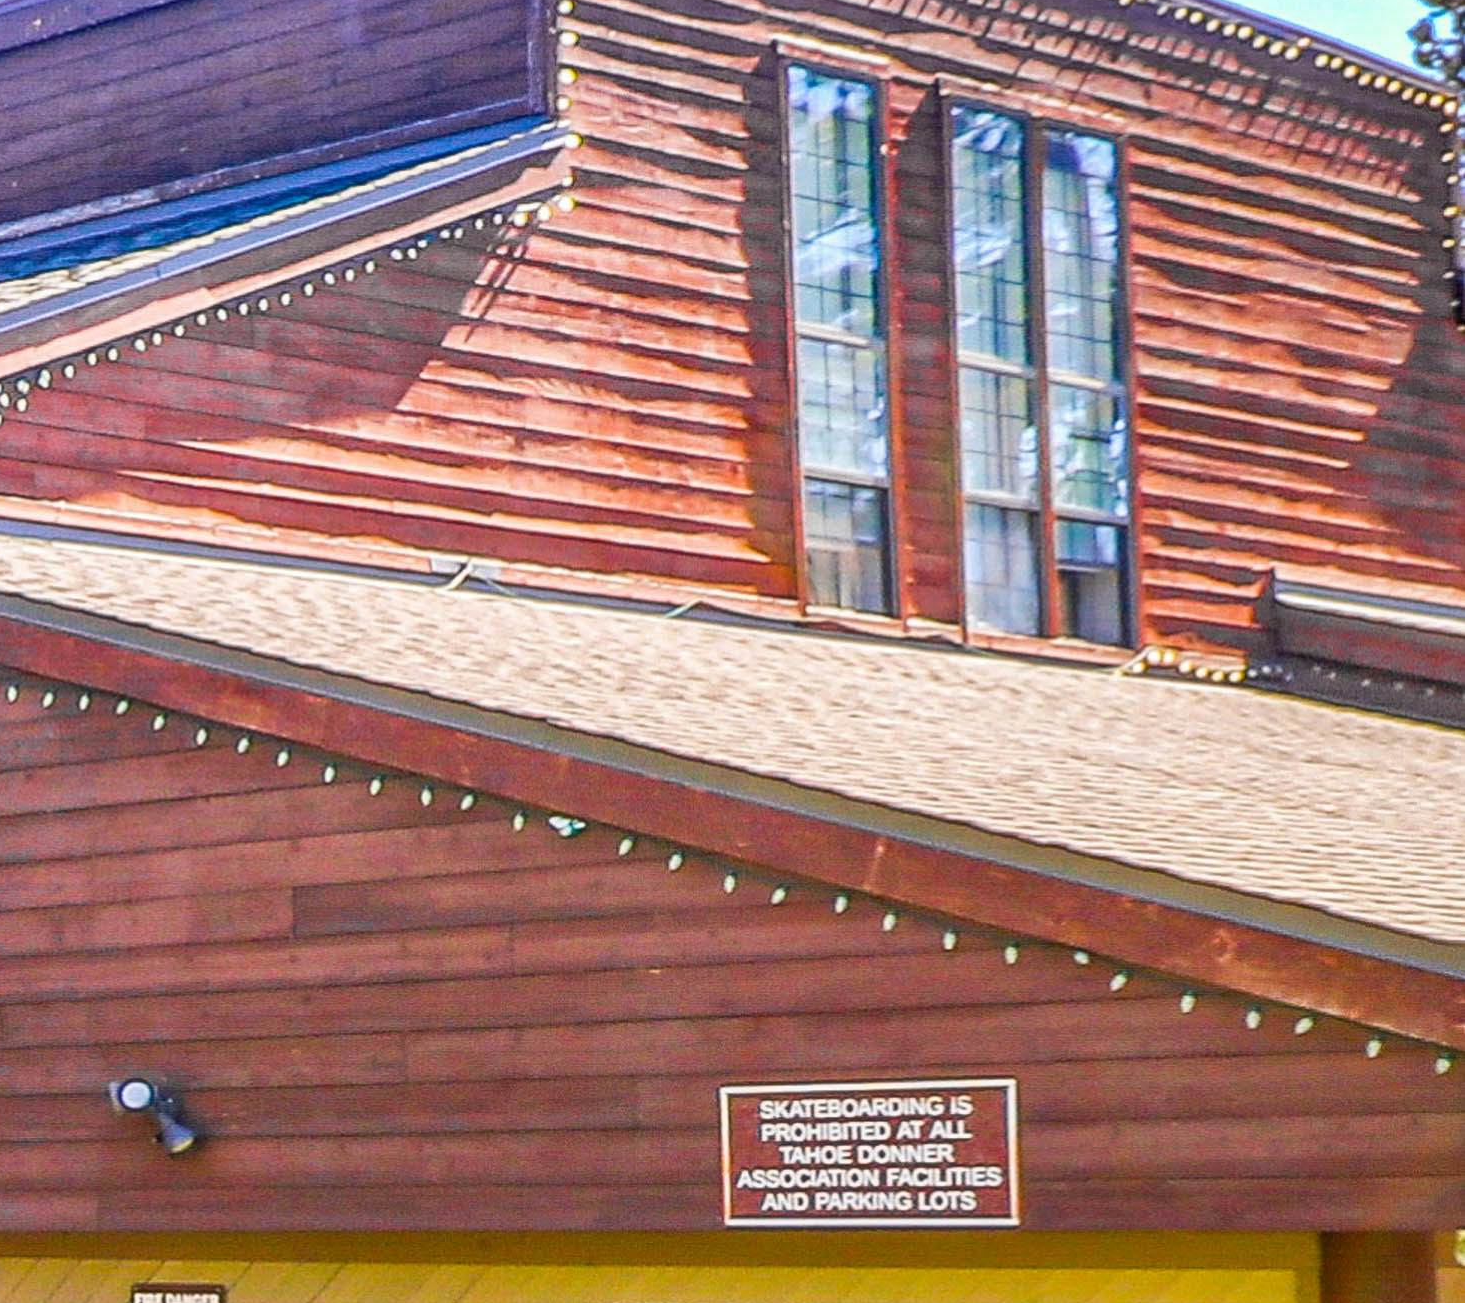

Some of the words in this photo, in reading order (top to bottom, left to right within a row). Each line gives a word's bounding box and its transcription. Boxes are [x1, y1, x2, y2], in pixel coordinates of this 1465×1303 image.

[759, 1096, 945, 1119] SKATEBOARDING
[949, 1094, 973, 1115] IS
[760, 1121, 891, 1142] PROHIBITED
[896, 1120, 926, 1140] AT
[928, 1119, 973, 1139] ALL
[778, 1145, 853, 1165] TAHOE
[857, 1143, 955, 1164] DONNER
[736, 1168, 880, 1189] ASSOCIATION
[886, 1166, 1003, 1187] FACILITIES
[761, 1192, 809, 1211] AND
[815, 1190, 913, 1211] PARKING
[918, 1190, 977, 1211] LOTS
